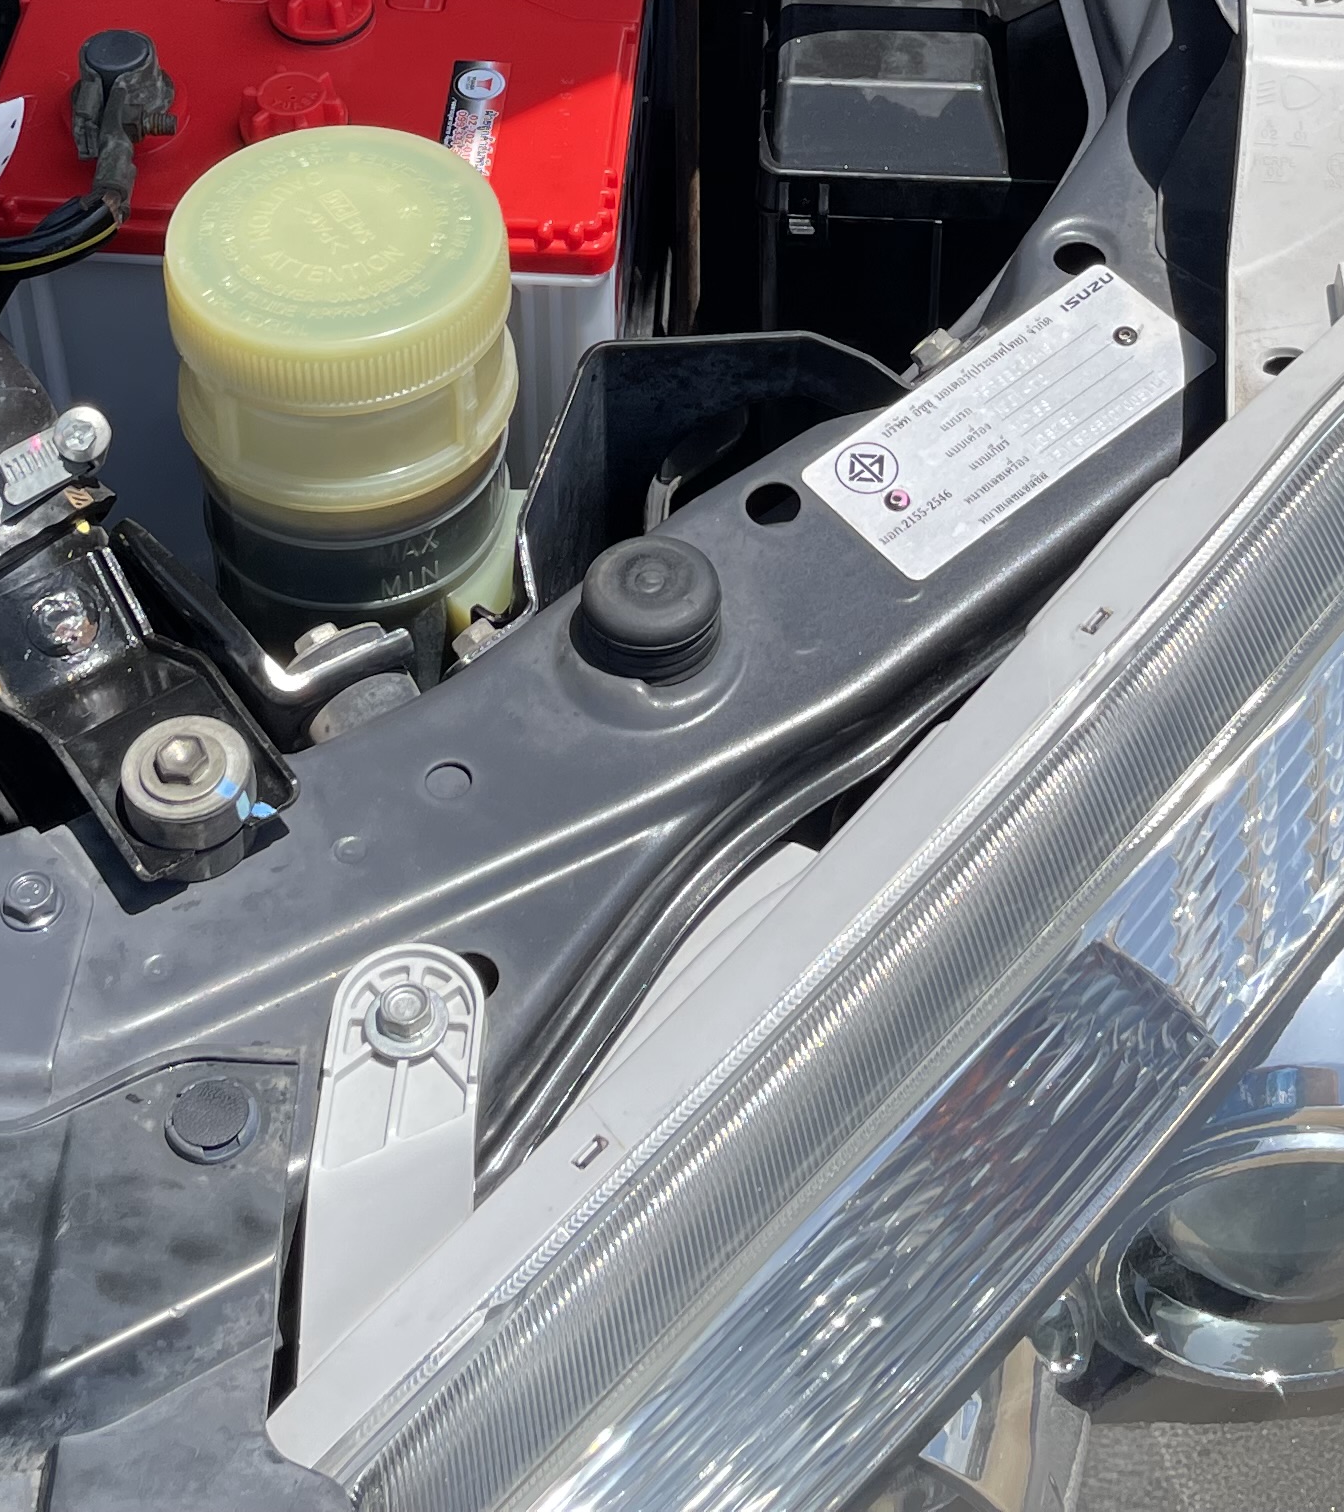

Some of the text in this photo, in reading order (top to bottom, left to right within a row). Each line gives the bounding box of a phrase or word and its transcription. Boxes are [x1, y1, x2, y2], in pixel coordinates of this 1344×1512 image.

[260, 243, 406, 284] ATTENTION
[1060, 272, 1114, 312] ISUZU
[376, 529, 439, 566] MAX
[381, 560, 438, 598] MIN
